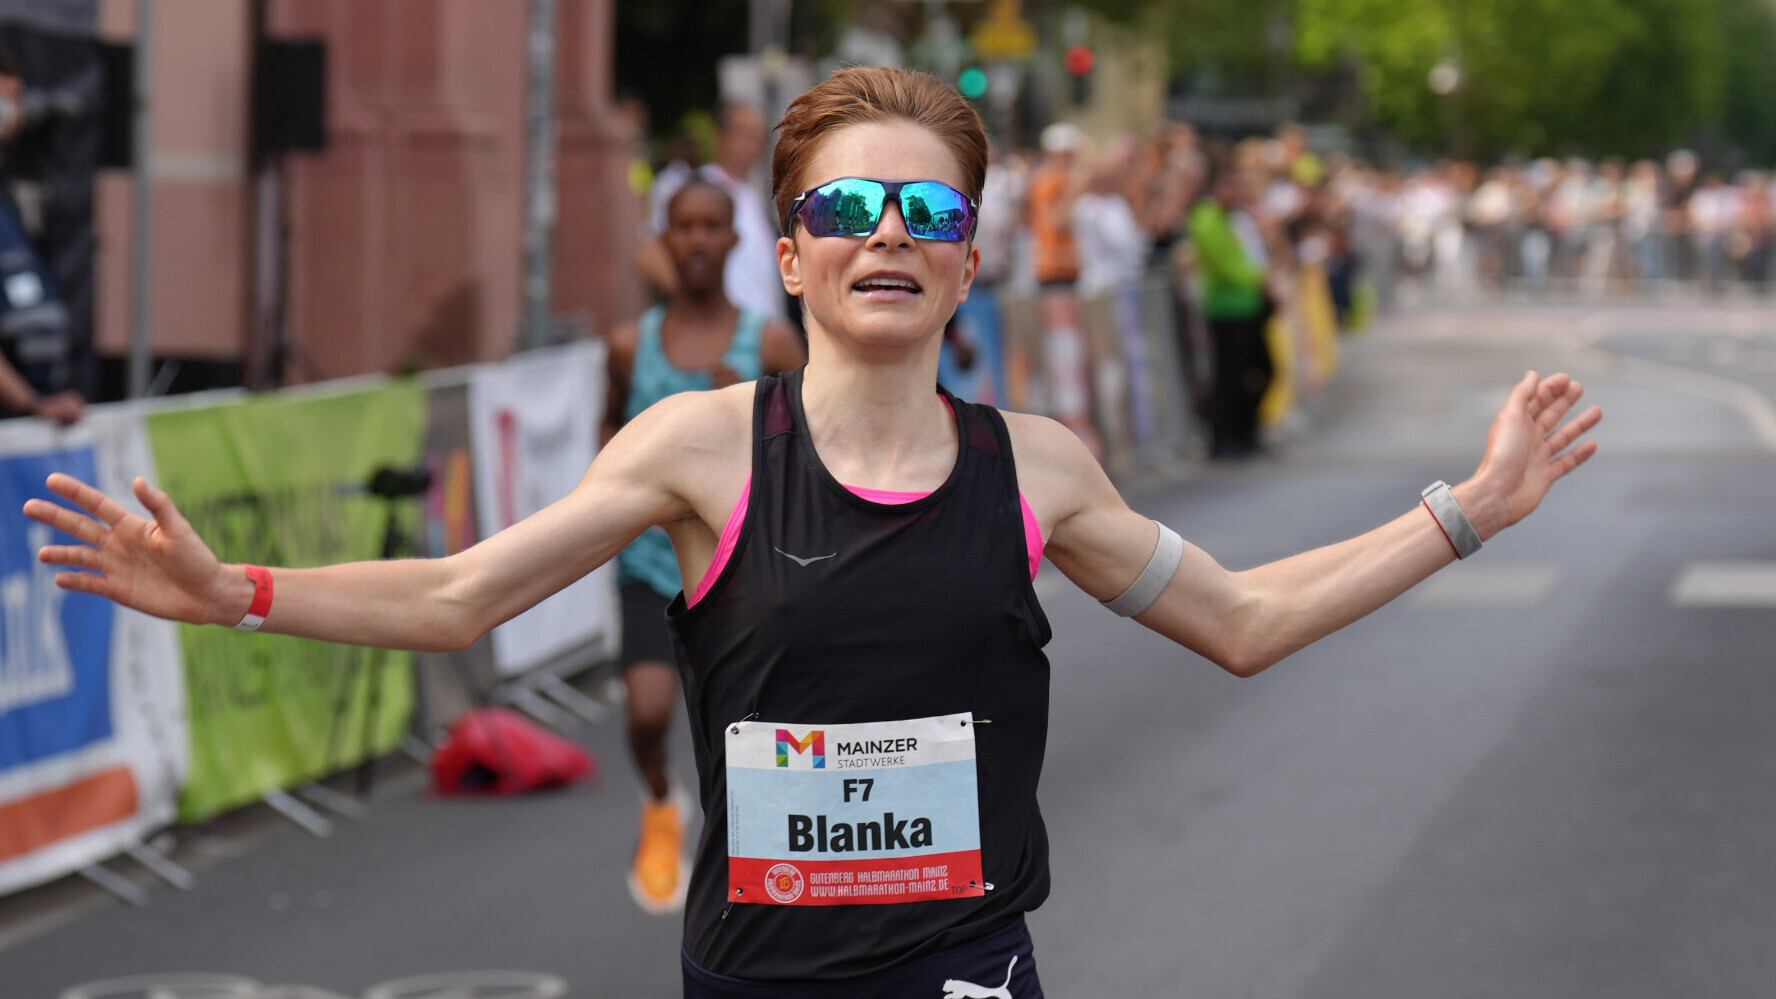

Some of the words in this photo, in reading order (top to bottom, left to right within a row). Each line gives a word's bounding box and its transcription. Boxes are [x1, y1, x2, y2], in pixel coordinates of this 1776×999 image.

[837, 738, 917, 756] MAINZER
[838, 756, 905, 769] STADTWERKE
[843, 778, 874, 802] F7
[788, 812, 933, 852] Blanka
[810, 872, 854, 884] GUTENBERG
[858, 868, 920, 883] HALBMARATHON
[922, 865, 948, 879] MAINZ
[810, 879, 949, 897] WWW.HALBMARATHON-MAINZ.DE
[952, 886, 967, 895] TOP
